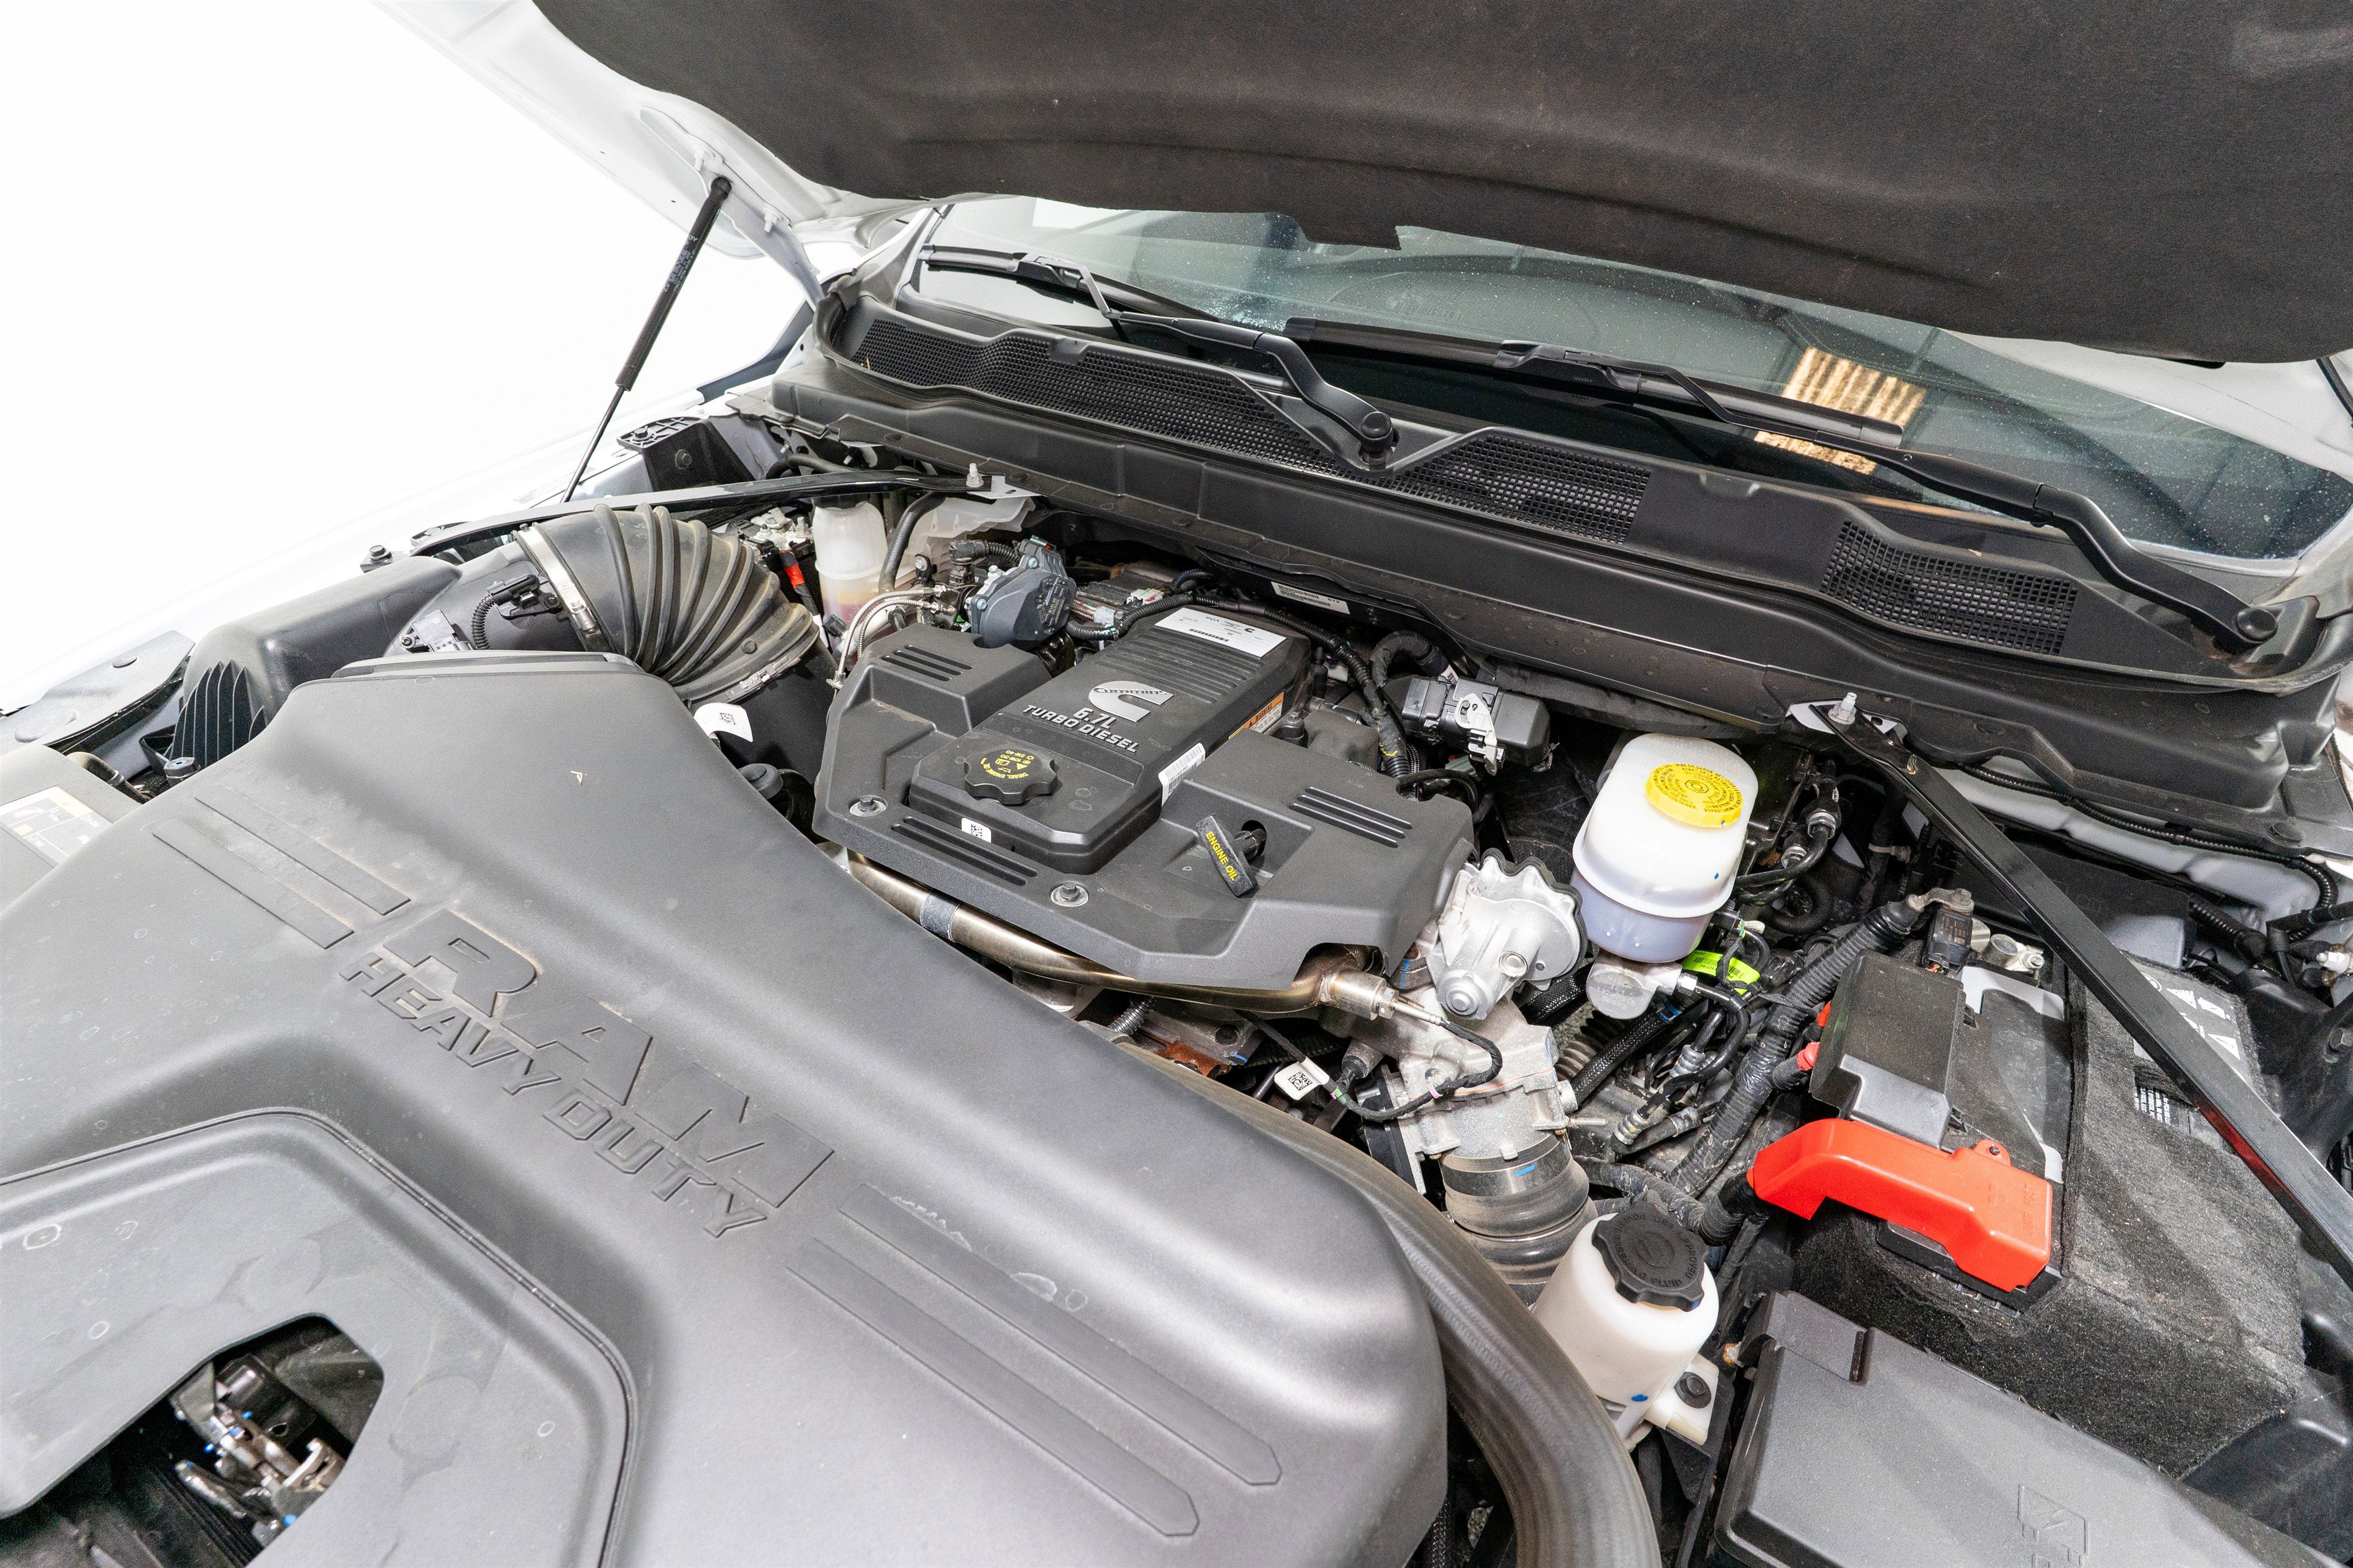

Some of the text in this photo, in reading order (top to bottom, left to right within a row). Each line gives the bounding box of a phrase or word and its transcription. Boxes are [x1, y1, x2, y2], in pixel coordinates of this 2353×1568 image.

[1093, 686, 1167, 695] Cummins
[1023, 705, 1139, 752] TURBO DIESEL
[1073, 707, 1117, 729] 6.7L
[1000, 754, 1021, 763] 10W-30
[1006, 750, 1025, 758] 5W-40
[986, 767, 1006, 779] ENGINE
[1205, 831, 1237, 882] ENGINE OIL
[384, 908, 835, 1208] RAM
[339, 951, 768, 1238] HEAVY DUTY
